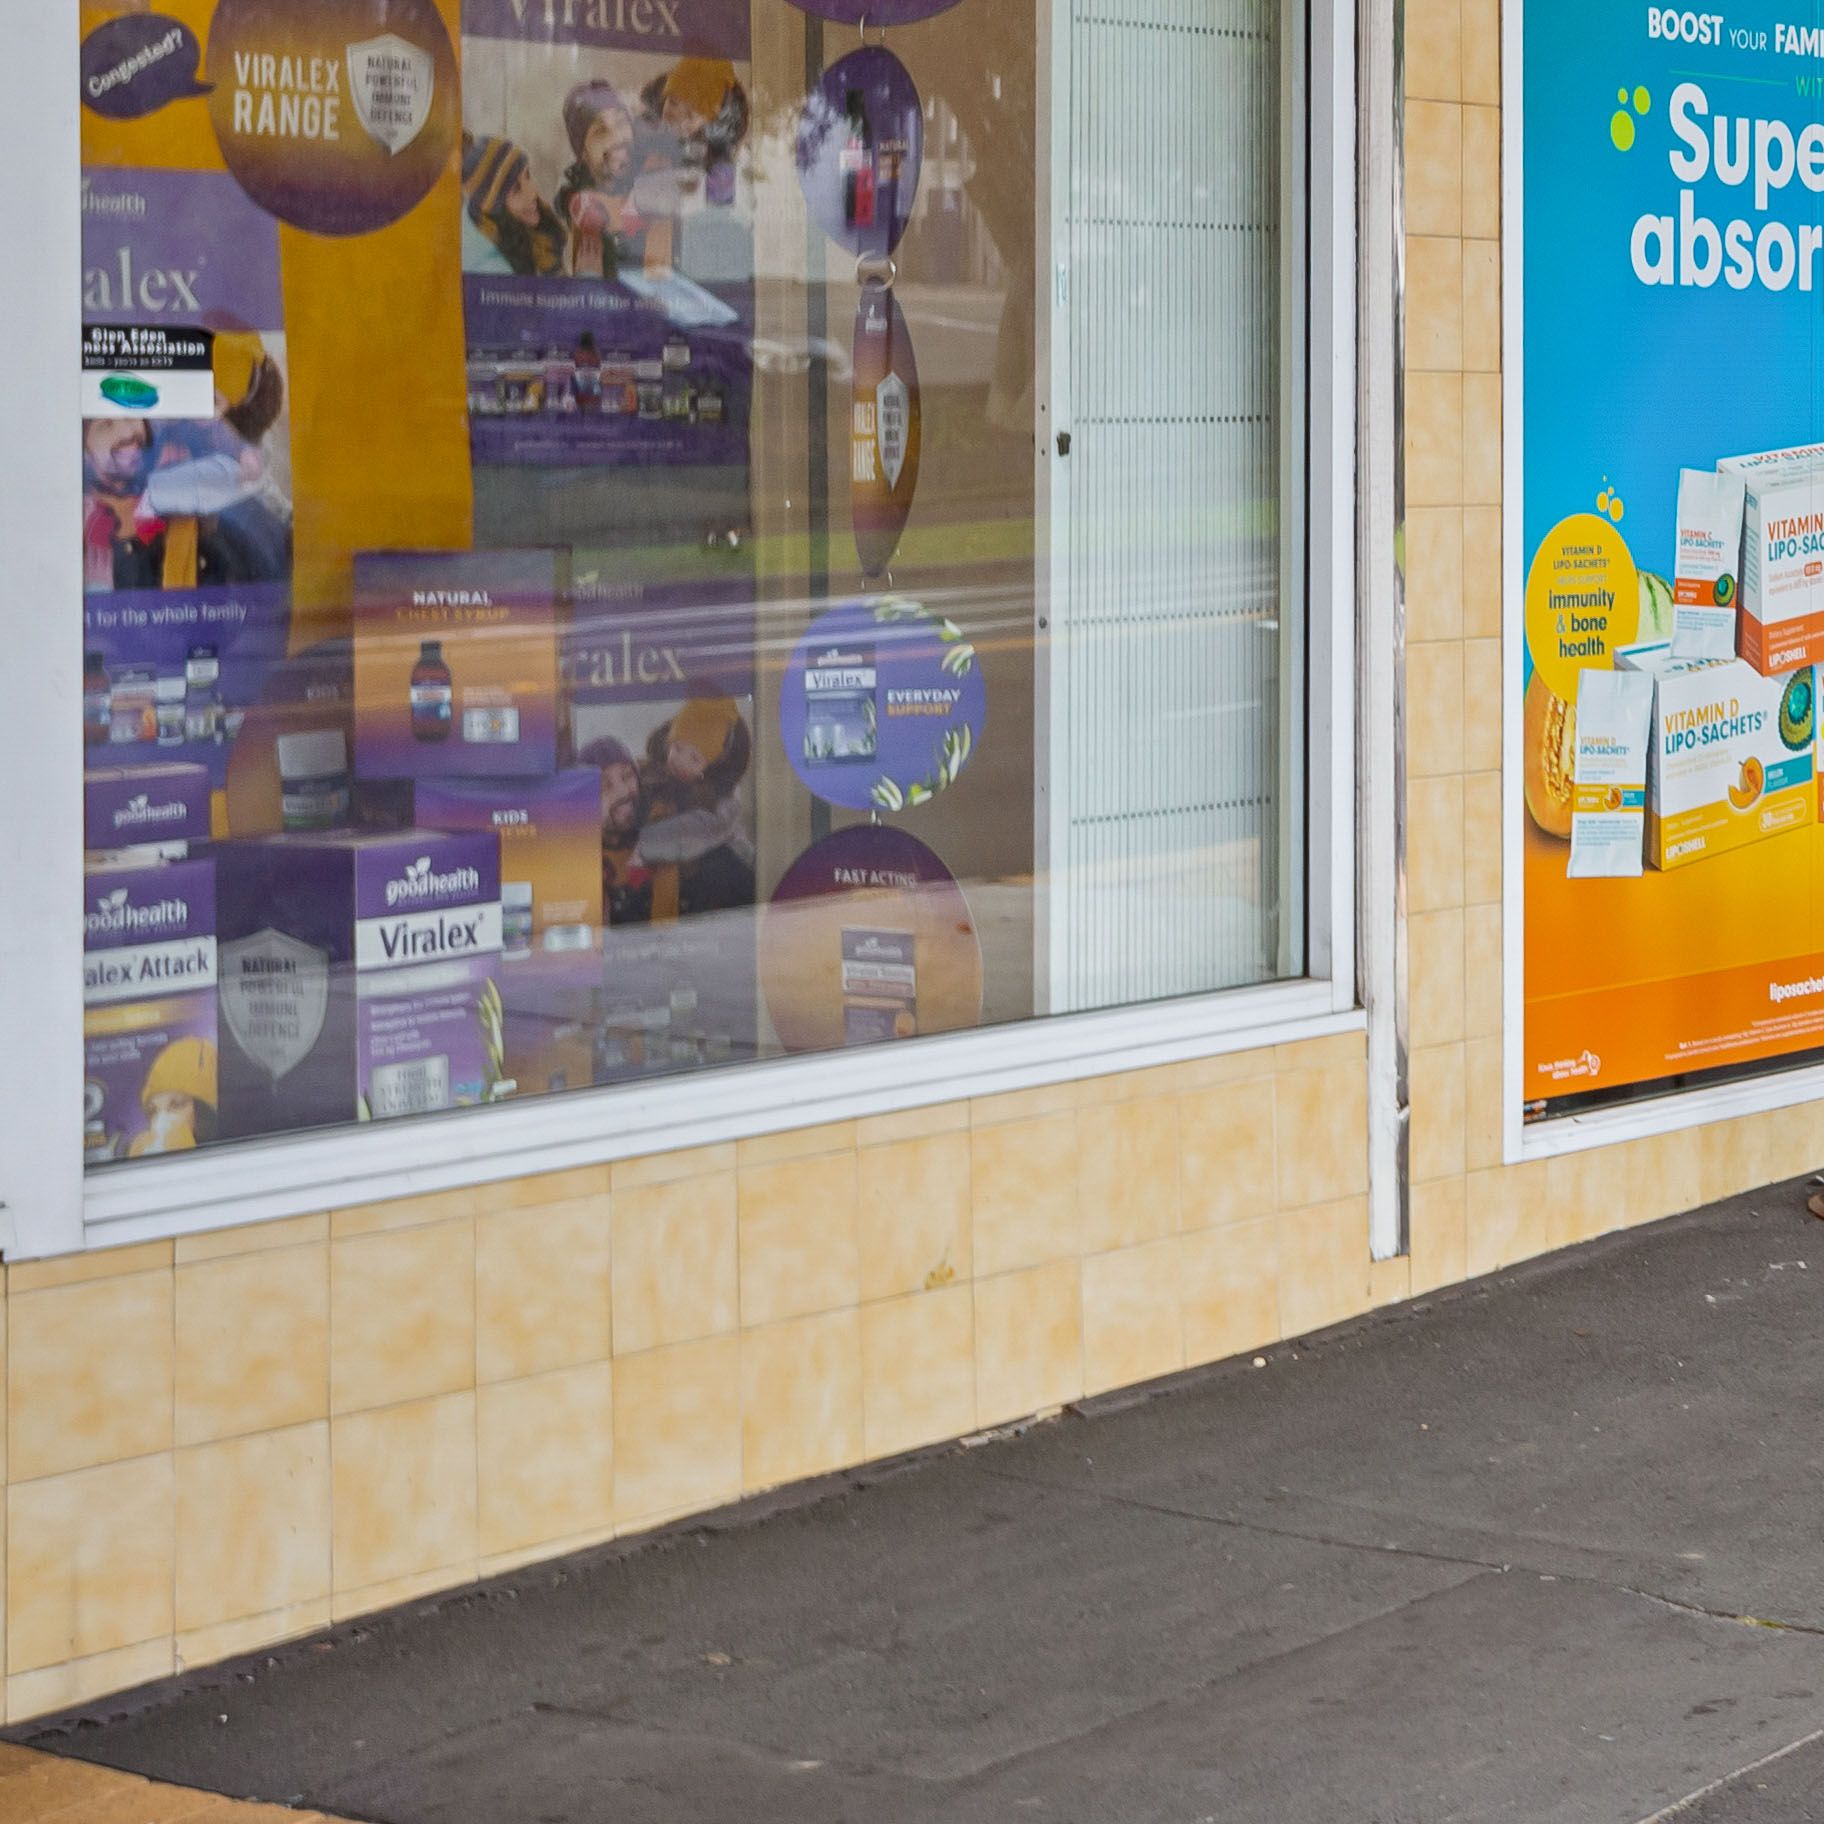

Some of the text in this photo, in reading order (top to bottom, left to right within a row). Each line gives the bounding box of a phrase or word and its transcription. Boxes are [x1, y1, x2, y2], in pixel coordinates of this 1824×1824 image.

[1647, 6, 1723, 46] BOOST
[1729, 27, 1768, 53] YOUR
[86, 26, 184, 99] Congested?
[233, 49, 340, 94] VIRALEX
[233, 89, 340, 142] RANGE
[1767, 511, 1824, 541] VITAMIN
[1561, 545, 1595, 556] VITAMIN
[412, 590, 492, 607] NATURAL
[1548, 586, 1616, 612] immunity
[1570, 613, 1608, 634] bone
[1558, 635, 1606, 659] health
[811, 669, 866, 690] Viralex
[887, 688, 962, 704] EVERYDAY
[1665, 697, 1740, 735] VITAMIN D
[1665, 712, 1763, 755] LIPO-SACHETS
[386, 866, 479, 907] goodhealth
[379, 914, 479, 960] Viralex
[138, 948, 210, 981] Attack
